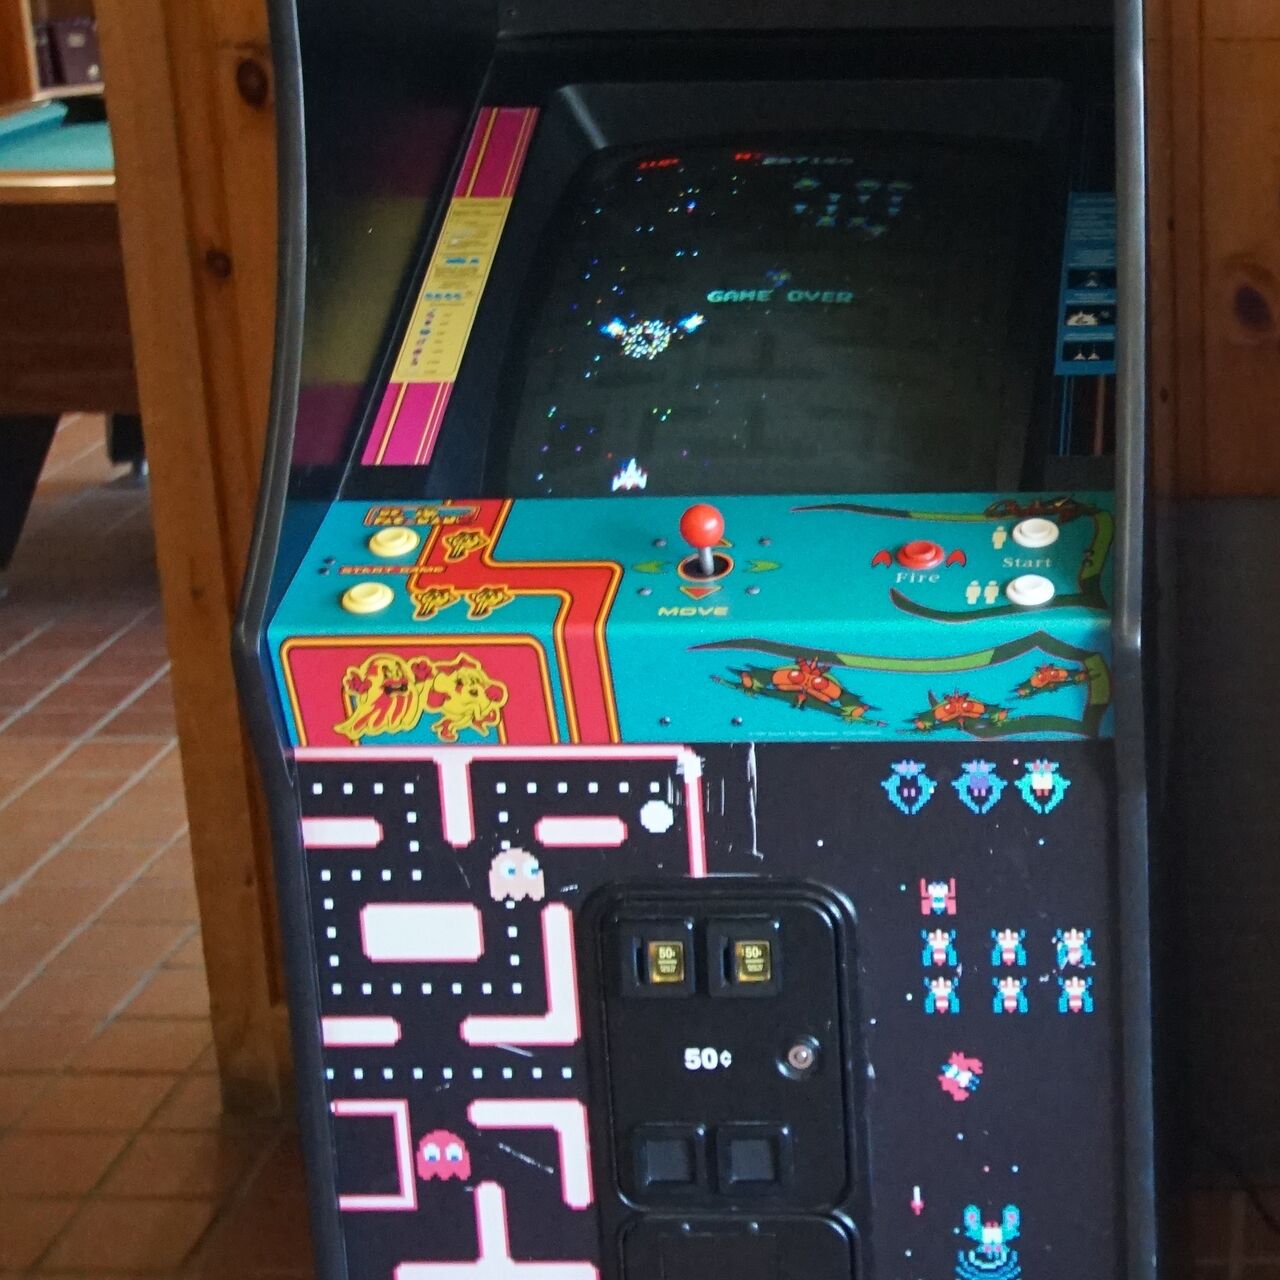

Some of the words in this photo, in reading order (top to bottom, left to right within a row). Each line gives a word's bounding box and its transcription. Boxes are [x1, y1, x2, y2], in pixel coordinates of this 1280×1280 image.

[707, 289, 771, 303] GAME
[787, 289, 853, 303] OVER
[1002, 556, 1053, 569] Start
[895, 572, 940, 584] Fire
[658, 606, 729, 617] MOVE
[684, 1047, 732, 1070] 50¢
